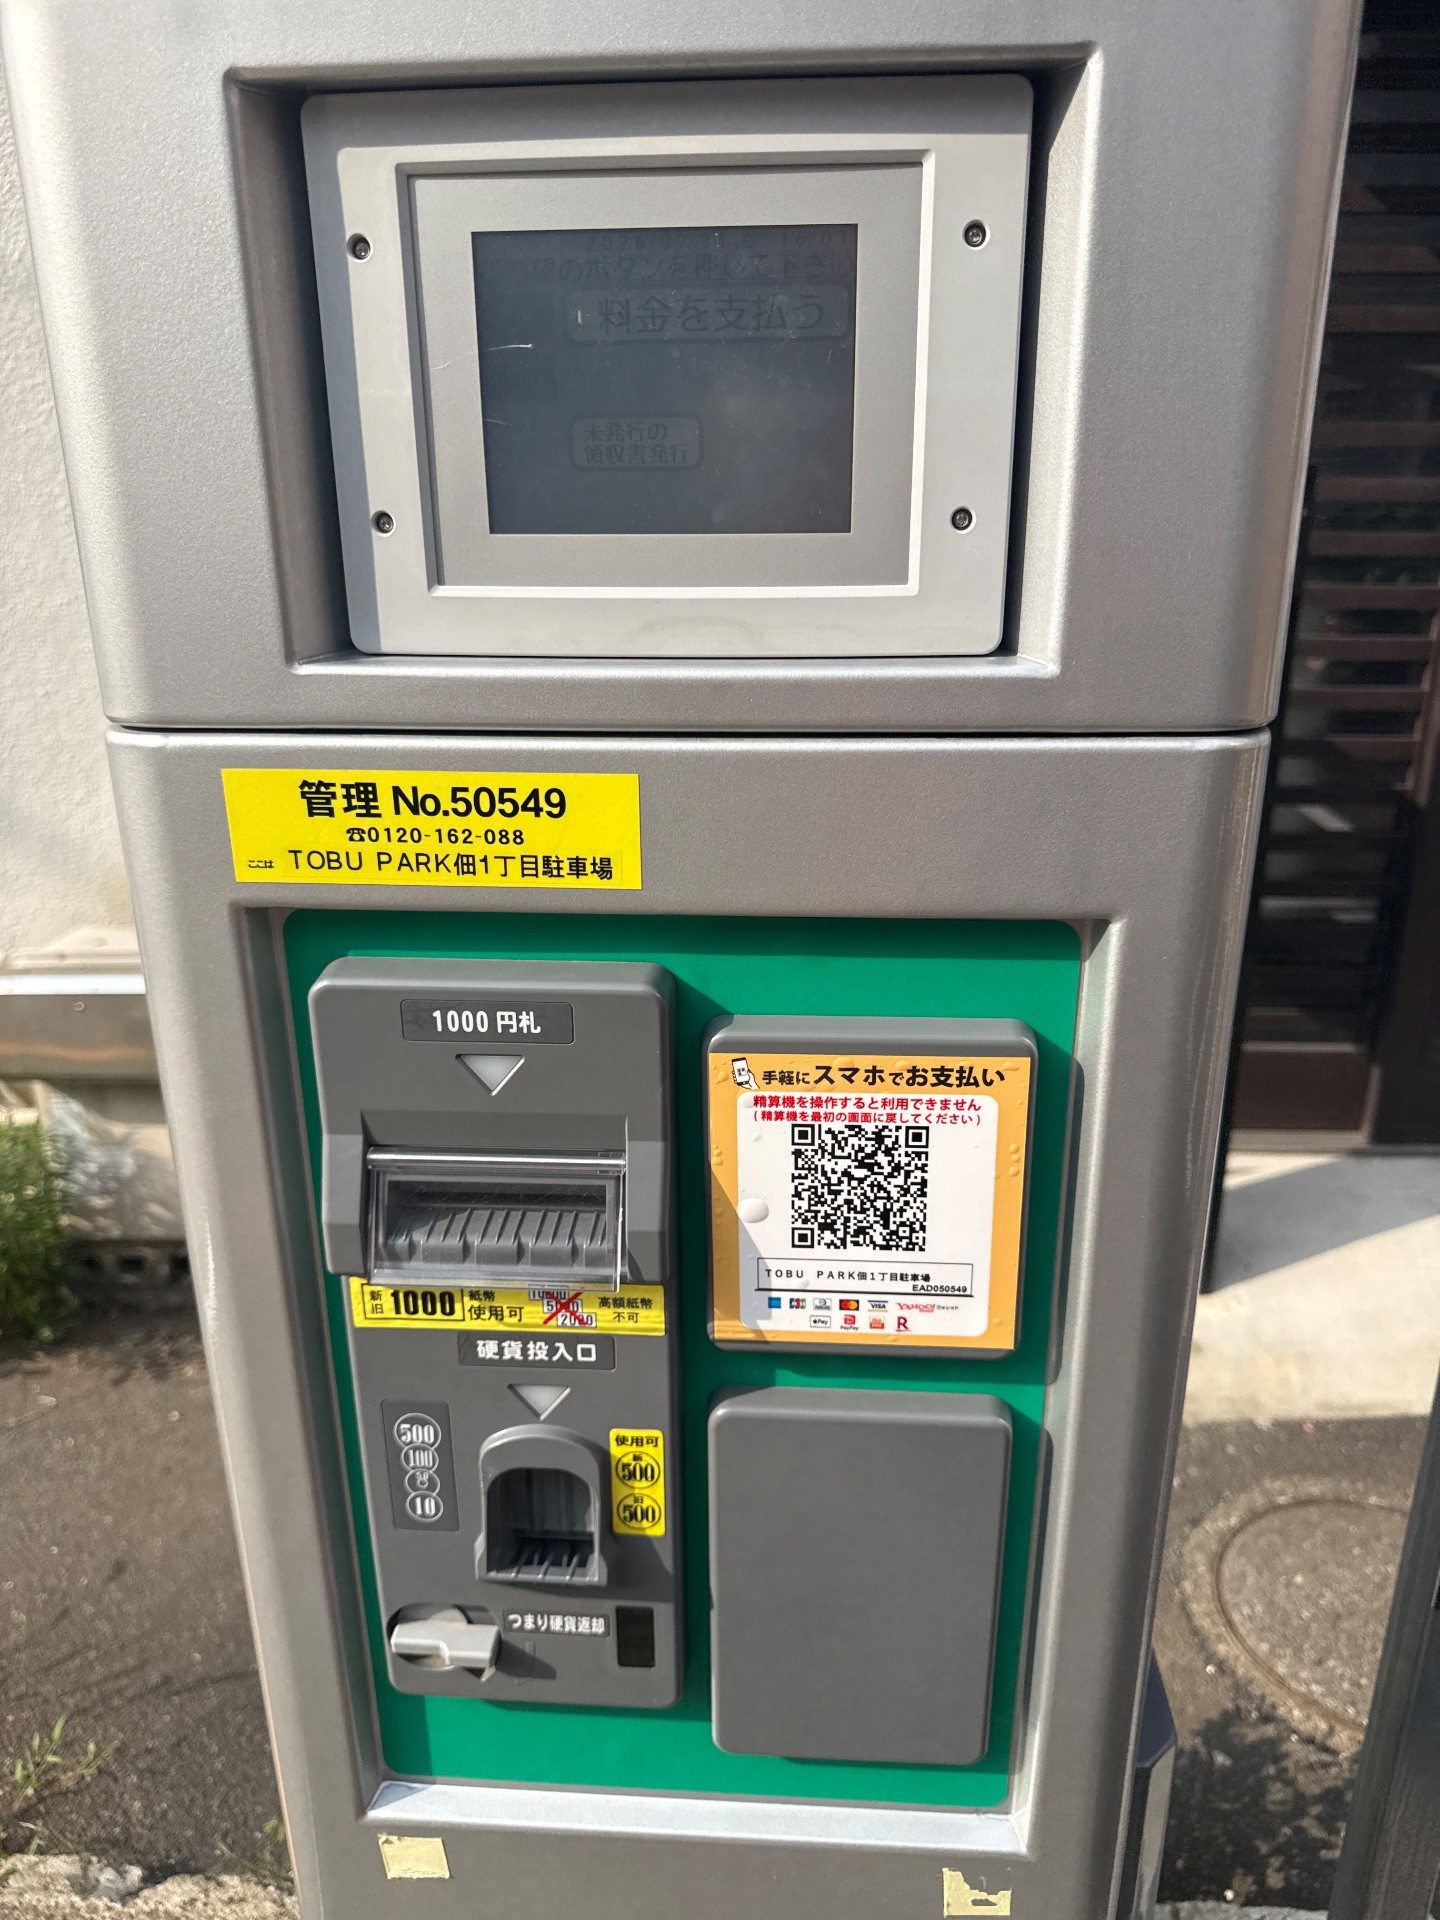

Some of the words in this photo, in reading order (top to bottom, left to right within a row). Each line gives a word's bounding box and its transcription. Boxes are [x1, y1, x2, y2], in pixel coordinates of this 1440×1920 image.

[598, 292, 823, 335] 料金を支払う
[298, 779, 382, 819] 管理
[392, 786, 567, 819] No.50549
[287, 849, 363, 872] TOBU
[761, 1064, 1006, 1089] 手軽にスマホでお支払い
[753, 1095, 982, 1112] 精算機を操作すると利用できません
[765, 1269, 804, 1279] TOBU
[912, 1284, 967, 1294] EAD050549
[391, 1289, 456, 1316] 1000
[467, 1305, 524, 1322] 使用可
[612, 1311, 640, 1323] 不可
[476, 1339, 597, 1363] 硬貨投入口
[399, 1423, 435, 1444] 500
[614, 1434, 660, 1448] 使用可
[407, 1449, 433, 1468] 100
[621, 1462, 655, 1482] 500
[415, 1496, 436, 1517] 10
[622, 1504, 656, 1523] 500
[507, 1613, 605, 1635] つまり硬貨返却
